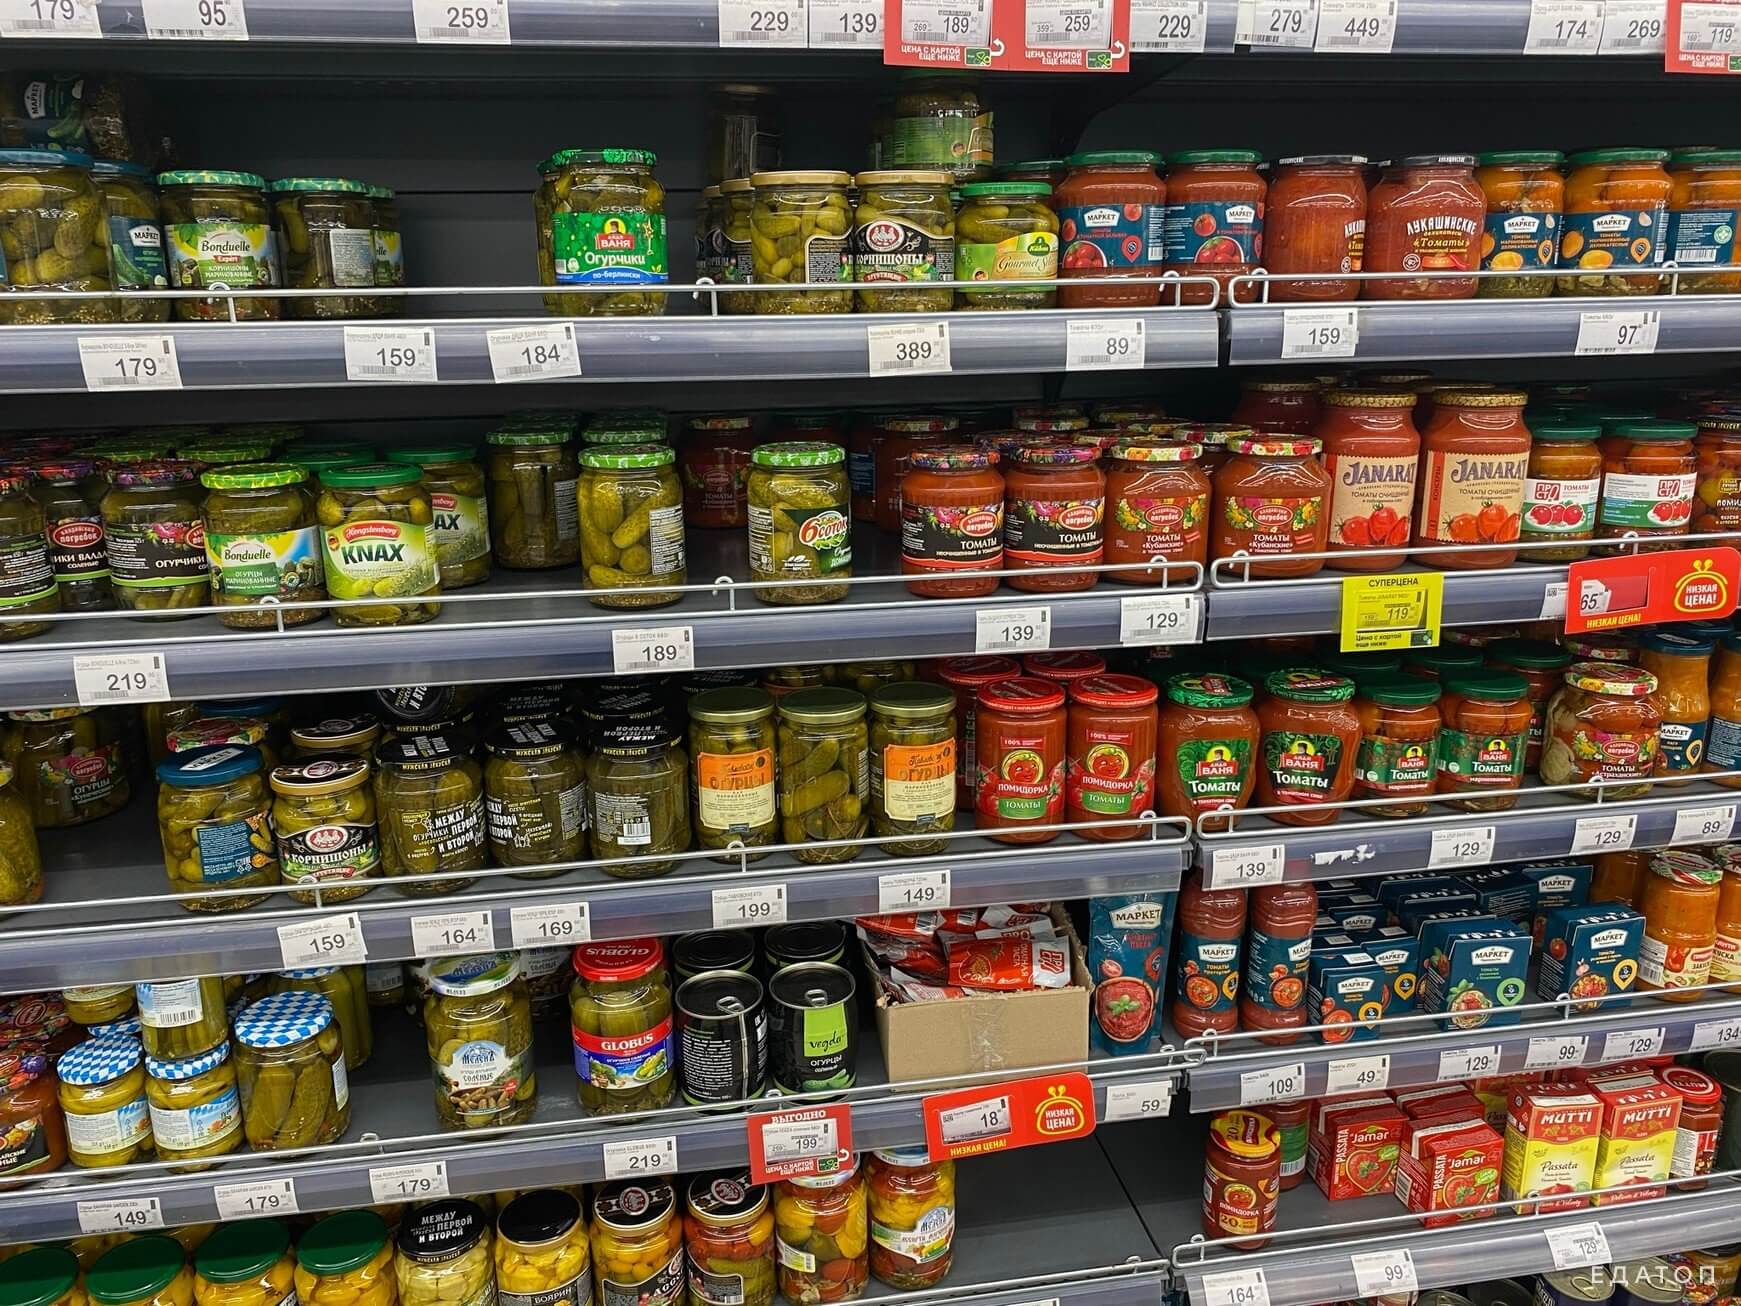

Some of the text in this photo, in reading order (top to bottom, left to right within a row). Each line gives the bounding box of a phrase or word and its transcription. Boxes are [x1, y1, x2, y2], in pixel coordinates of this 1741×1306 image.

[30, 0, 76, 20] 179
[198, 3, 226, 25] 95
[447, 7, 488, 28] 259
[751, 11, 789, 31] 229
[840, 12, 877, 33] 139
[944, 17, 969, 33] 189
[1065, 16, 1090, 31] 259
[1159, 15, 1191, 38] 229
[1271, 9, 1301, 33] 279
[1345, 19, 1379, 36] 449
[1555, 21, 1587, 39] 174
[1628, 20, 1659, 38] 269
[1711, 29, 1732, 42] 119
[901, 46, 922, 54] ЦЕНА
[931, 47, 960, 55] КАРТОЙ
[1407, 216, 1477, 236] ЛУКАШИНСКИЕ
[202, 241, 250, 254] Bonduelle
[601, 239, 631, 248] ВАНЯ
[585, 253, 645, 266] Огурчики
[593, 271, 641, 279] по-берлински
[1308, 328, 1342, 347] 159
[1618, 325, 1638, 346] 97
[896, 341, 932, 361] 389
[1106, 336, 1129, 357] 89
[376, 348, 416, 368] 159
[522, 344, 560, 366] 184
[115, 357, 157, 377] 179
[1343, 462, 1416, 485] JANARAT
[1451, 459, 1527, 483] JANARAT
[345, 524, 397, 538] Hengstenberg
[1059, 531, 1096, 542] ТОМАТЫ
[1146, 534, 1181, 542] ТОМАТЫ
[1253, 534, 1290, 542] ТОМАТЫ
[60, 534, 97, 544] погребок
[961, 538, 997, 550] ТОМАТЫ
[1143, 541, 1184, 549] «Кубанские»
[1249, 541, 1293, 549] «Кубанские»
[225, 549, 271, 562] Bonduelle
[342, 544, 404, 564] KNAX
[155, 557, 204, 568] ОГУРЧИКИ
[1368, 577, 1418, 587] СУПЕРЦЕНА
[1686, 584, 1717, 593] НИЗКАЯ
[1581, 593, 1596, 610] 65
[1685, 594, 1717, 606] ЦЕНА!
[1146, 612, 1178, 629] 129
[1387, 607, 1408, 620] 119
[1587, 613, 1641, 628] НИЗКАЯ ЦЕНА!
[1002, 625, 1034, 642] 139
[1379, 633, 1401, 641] картой
[642, 645, 677, 663] 189
[107, 673, 147, 691] 219
[1285, 760, 1319, 769] ВАНЯ
[1483, 753, 1507, 761] ВАНЯ
[899, 766, 950, 781] ОГУРЦЫ
[1202, 766, 1233, 774] ВАНЯ
[1390, 770, 1428, 780] Томаты
[1472, 762, 1511, 773] Томаты
[710, 774, 765, 789] ОГУРЦЫ
[1083, 776, 1133, 789] ПОМИДОРКА
[1189, 780, 1241, 793] Томаты
[1273, 771, 1328, 788] Томаты
[998, 783, 1048, 794] ПОМИДОРКА
[1089, 794, 1124, 804] ТОМАТЫ
[435, 809, 465, 827] МЕЖДУ
[493, 815, 517, 826] ПЕРВОЙ
[413, 815, 477, 841] ОГУРЧИКИ ПЕРВОЙ
[491, 828, 513, 839] ВТОРОЙ
[1702, 820, 1720, 834] 89
[439, 832, 474, 853] И ВТОРОЙ
[1594, 831, 1621, 846] 129
[291, 845, 367, 865] КОРНИШОНЫ
[1452, 842, 1479, 857] 129
[1236, 862, 1266, 878] 139
[903, 887, 935, 903] 149
[738, 903, 770, 918] 199
[1116, 909, 1161, 921] МАРКЕТ
[538, 921, 573, 938] 169
[1346, 918, 1372, 926] МАРКЕТ
[309, 934, 345, 953] 159
[441, 927, 477, 945] 164
[1594, 933, 1624, 943] МАРКЕТ
[1379, 953, 1406, 962] МАРКЕТ
[1475, 951, 1509, 959] МАРКЕТ
[601, 1033, 654, 1050] GLOBUS
[809, 1031, 842, 1051] vegda
[1717, 1028, 1738, 1042] 134
[1559, 1045, 1576, 1060] 99
[1629, 1039, 1651, 1053] 129
[811, 1055, 842, 1066] ОГУРЦЫ
[1465, 1055, 1489, 1071] 129
[1357, 1070, 1375, 1083] 49
[1268, 1079, 1293, 1095] 109
[1045, 1108, 1074, 1117] НИЗКАЯ
[1142, 1099, 1160, 1113] 59
[771, 1110, 826, 1124] ВЫГОДНО
[980, 1111, 998, 1127] 18
[1541, 1110, 1592, 1124] MUTTI
[1623, 1105, 1671, 1124] MUTTI
[1046, 1119, 1075, 1129] ЦЕНА!
[795, 1138, 817, 1150] 199
[1352, 1131, 1389, 1144] Jamar
[951, 1140, 1006, 1156] НИЗКАЯ ЦЕНА!
[1336, 1129, 1350, 1163] PASSATA
[629, 1154, 661, 1169] 219
[765, 1165, 782, 1174] ЦЕНА
[789, 1161, 814, 1169] КАРТОЙ
[1449, 1156, 1486, 1169] Jamar
[1540, 1161, 1578, 1172] Passata
[1620, 1154, 1656, 1166] Passata
[1433, 1154, 1447, 1190] PASSATA
[398, 1178, 431, 1195] 179
[244, 1195, 280, 1210] 179
[1219, 1202, 1259, 1216] ПОМИДОРКА
[113, 1211, 147, 1226] 149
[421, 1211, 456, 1225] МЕЖДУ
[438, 1215, 473, 1232] ПЕРВОЙ
[1221, 1215, 1239, 1227] 20
[428, 1227, 463, 1243] ВТОРОЙ
[1579, 1241, 1597, 1255] 129
[1384, 1265, 1403, 1281] 99
[534, 1287, 572, 1303] БОЯРИН
[1227, 1287, 1254, 1303] 164
